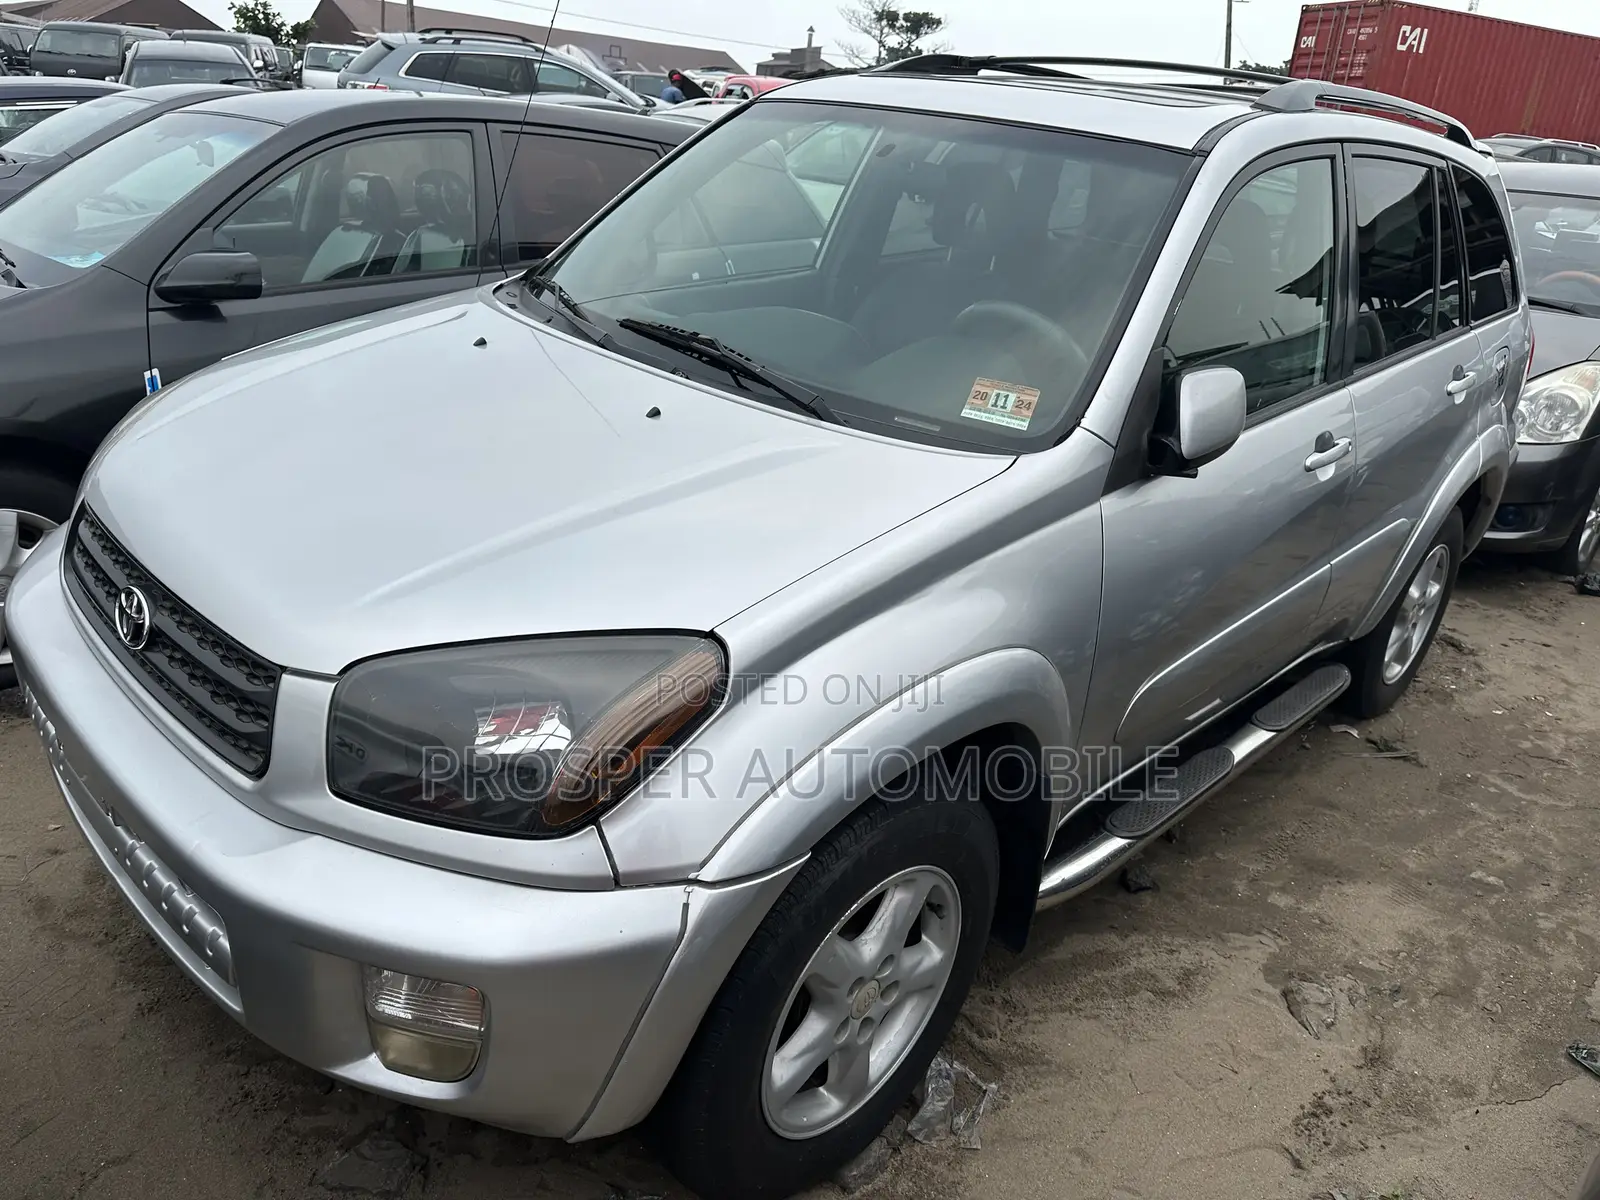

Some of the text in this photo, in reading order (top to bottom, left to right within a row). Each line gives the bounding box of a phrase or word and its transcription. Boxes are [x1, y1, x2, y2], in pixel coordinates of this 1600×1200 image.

[1300, 36, 1316, 48] CAI
[1396, 25, 1428, 54] CAI
[973, 391, 1032, 410] 20 11 24
